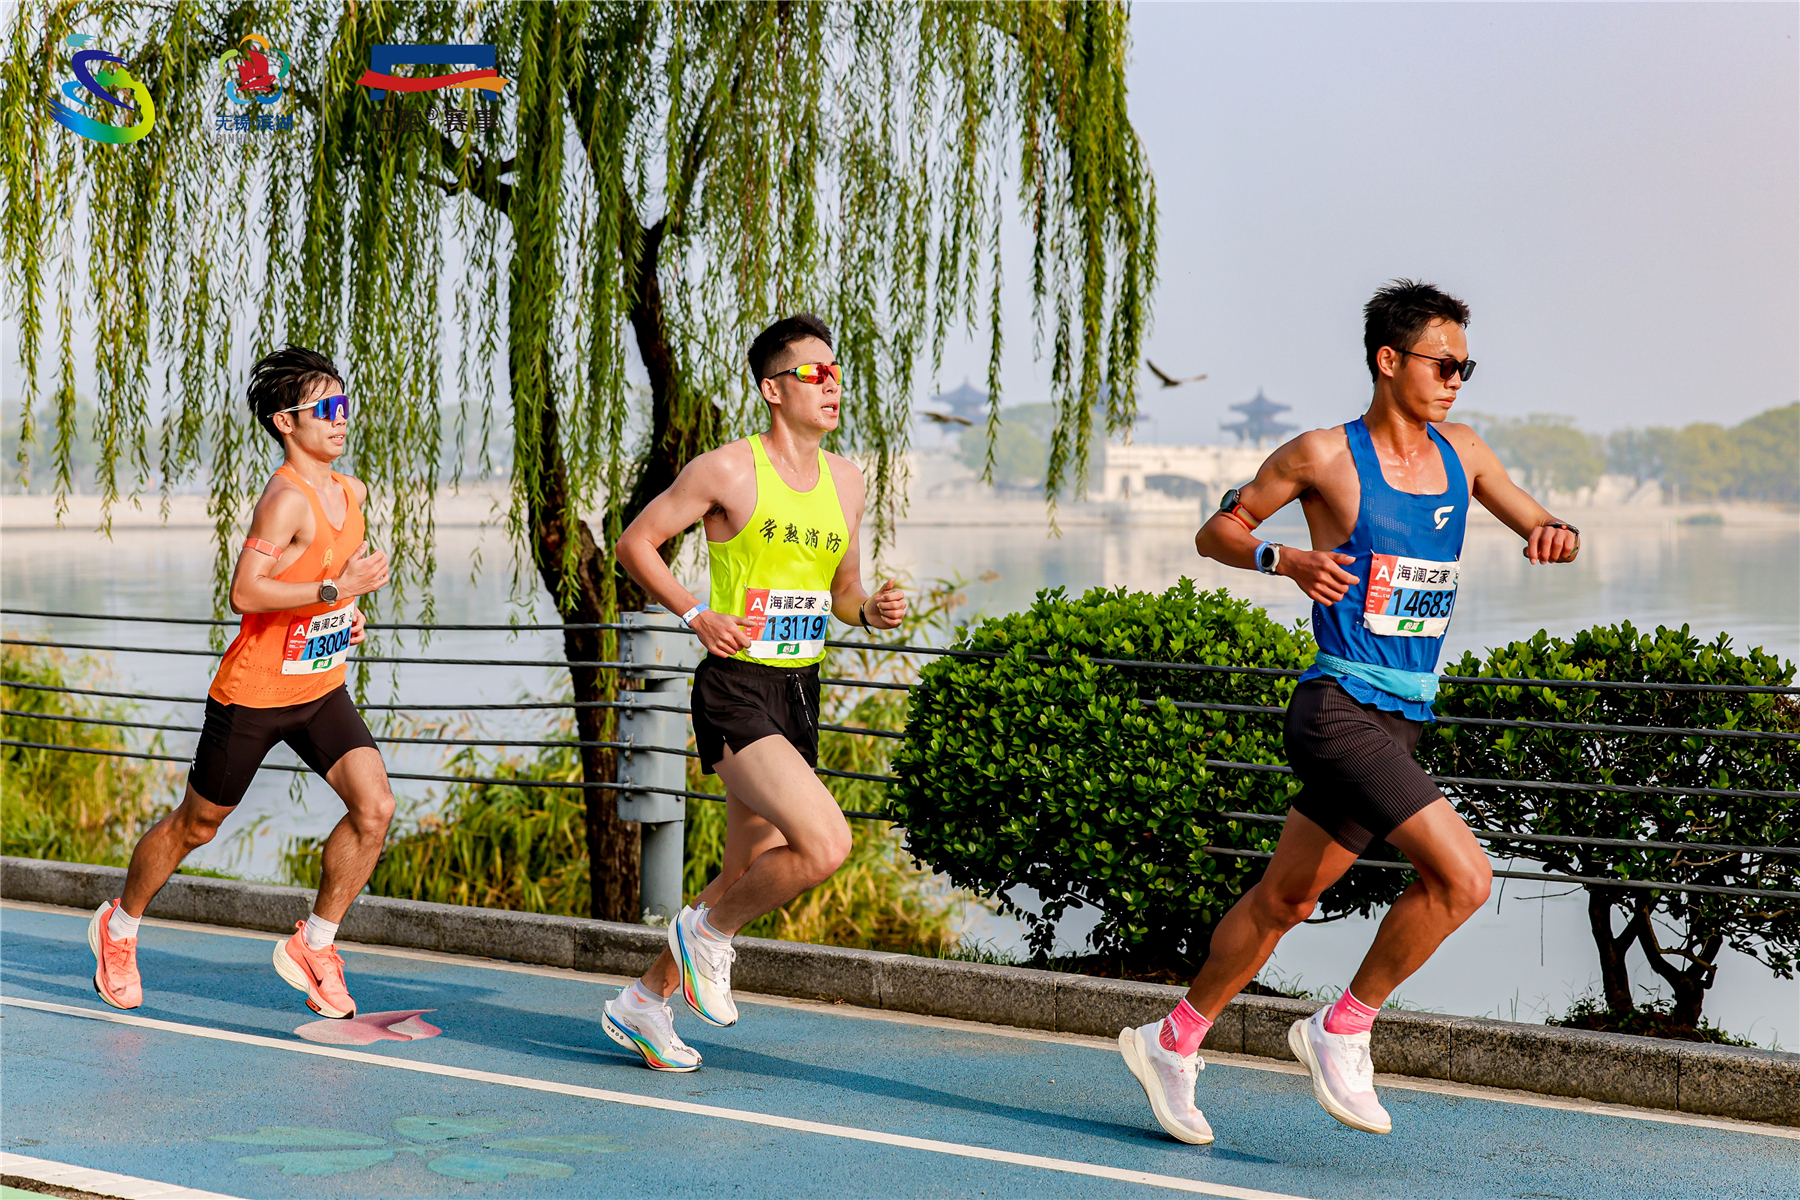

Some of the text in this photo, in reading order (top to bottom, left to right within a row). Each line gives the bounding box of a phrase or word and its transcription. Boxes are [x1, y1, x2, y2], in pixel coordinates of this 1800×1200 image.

[759, 518, 842, 554] 常熟消防
[1375, 565, 1390, 582] A
[1396, 564, 1450, 584] 海澜之家
[750, 597, 764, 612] A
[769, 595, 817, 610] 海澜之家
[1393, 588, 1453, 618] 14683
[293, 624, 306, 637] A
[310, 613, 346, 633] 海澜之家
[768, 616, 824, 640] 13119
[307, 627, 351, 659] 13004
